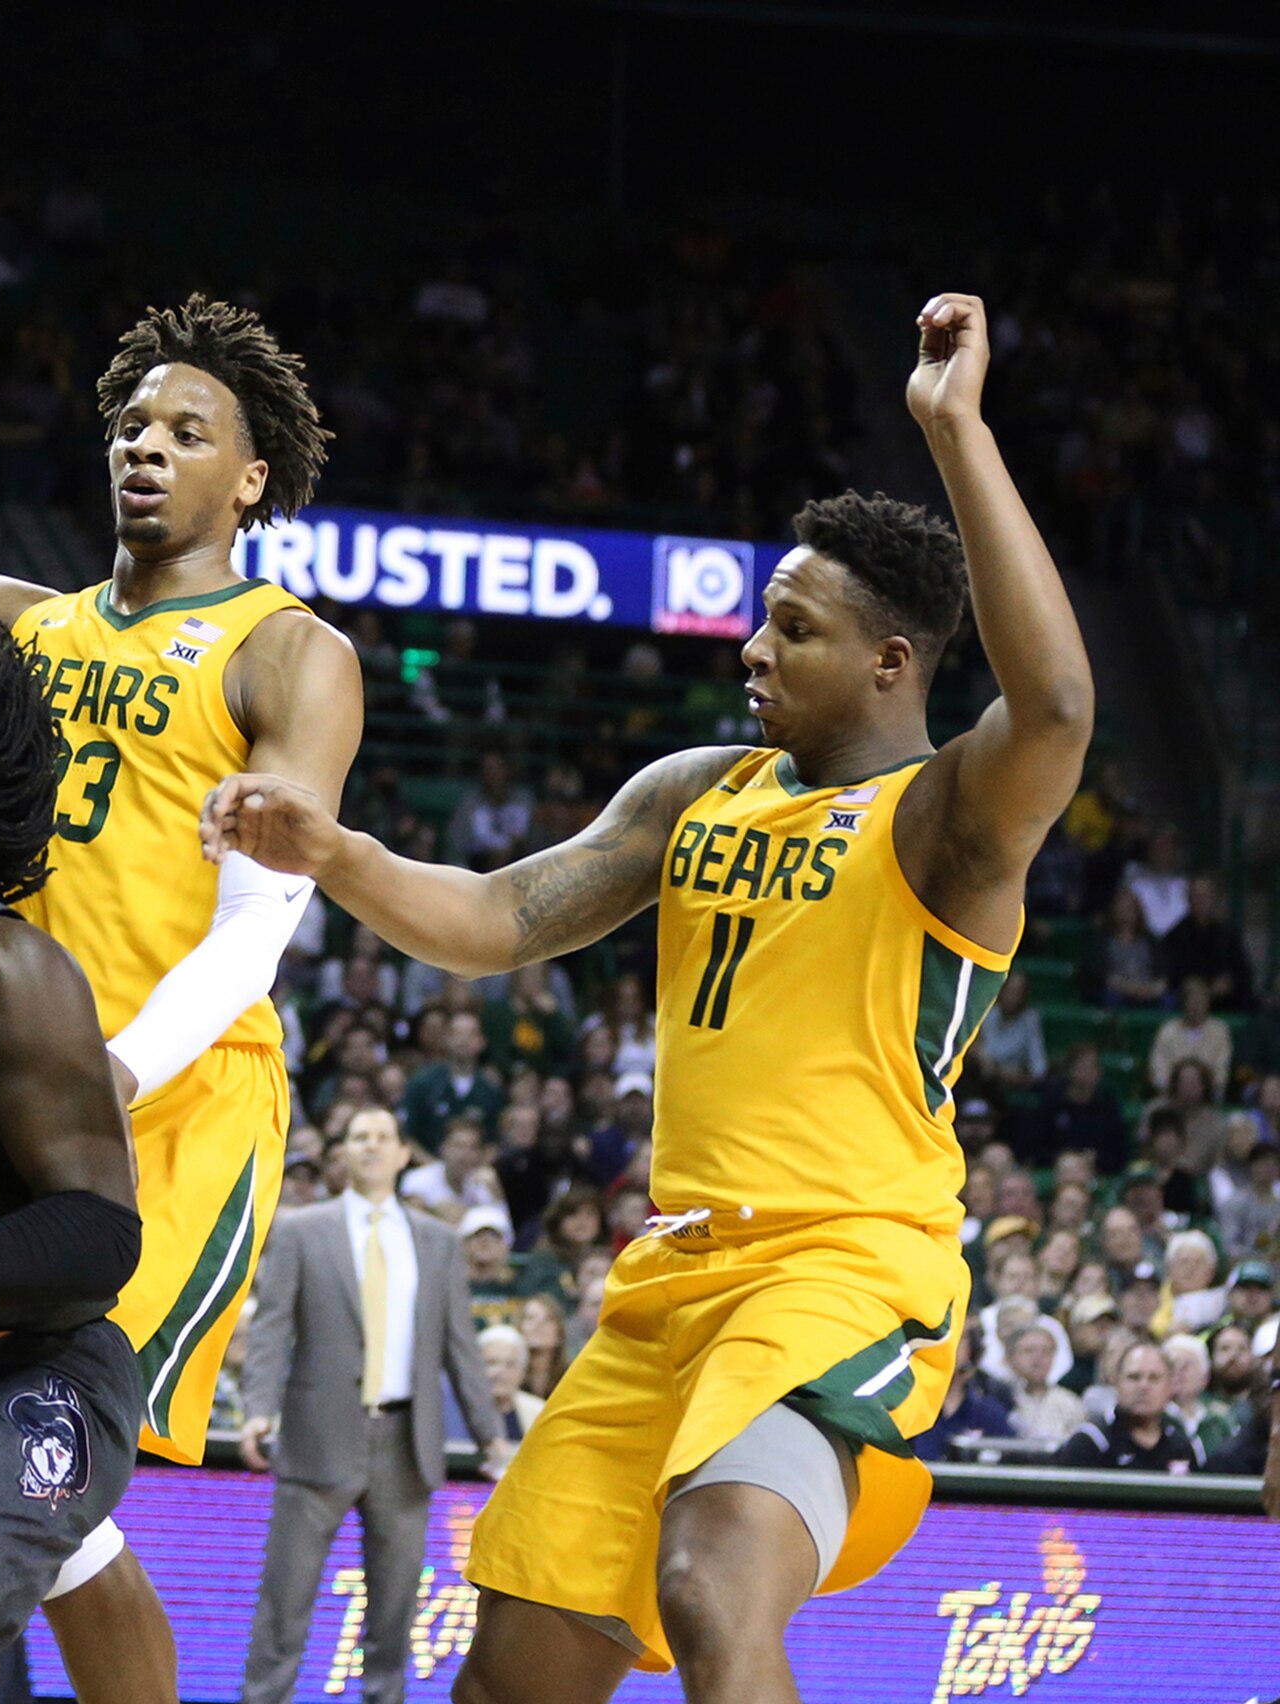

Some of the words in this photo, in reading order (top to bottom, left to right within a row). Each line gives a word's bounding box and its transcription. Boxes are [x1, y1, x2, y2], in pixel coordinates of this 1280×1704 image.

[51, 737, 122, 844] 3
[669, 821, 847, 901] BEARS
[689, 912, 754, 1031] 11
[928, 1581, 1102, 1704] Takis
